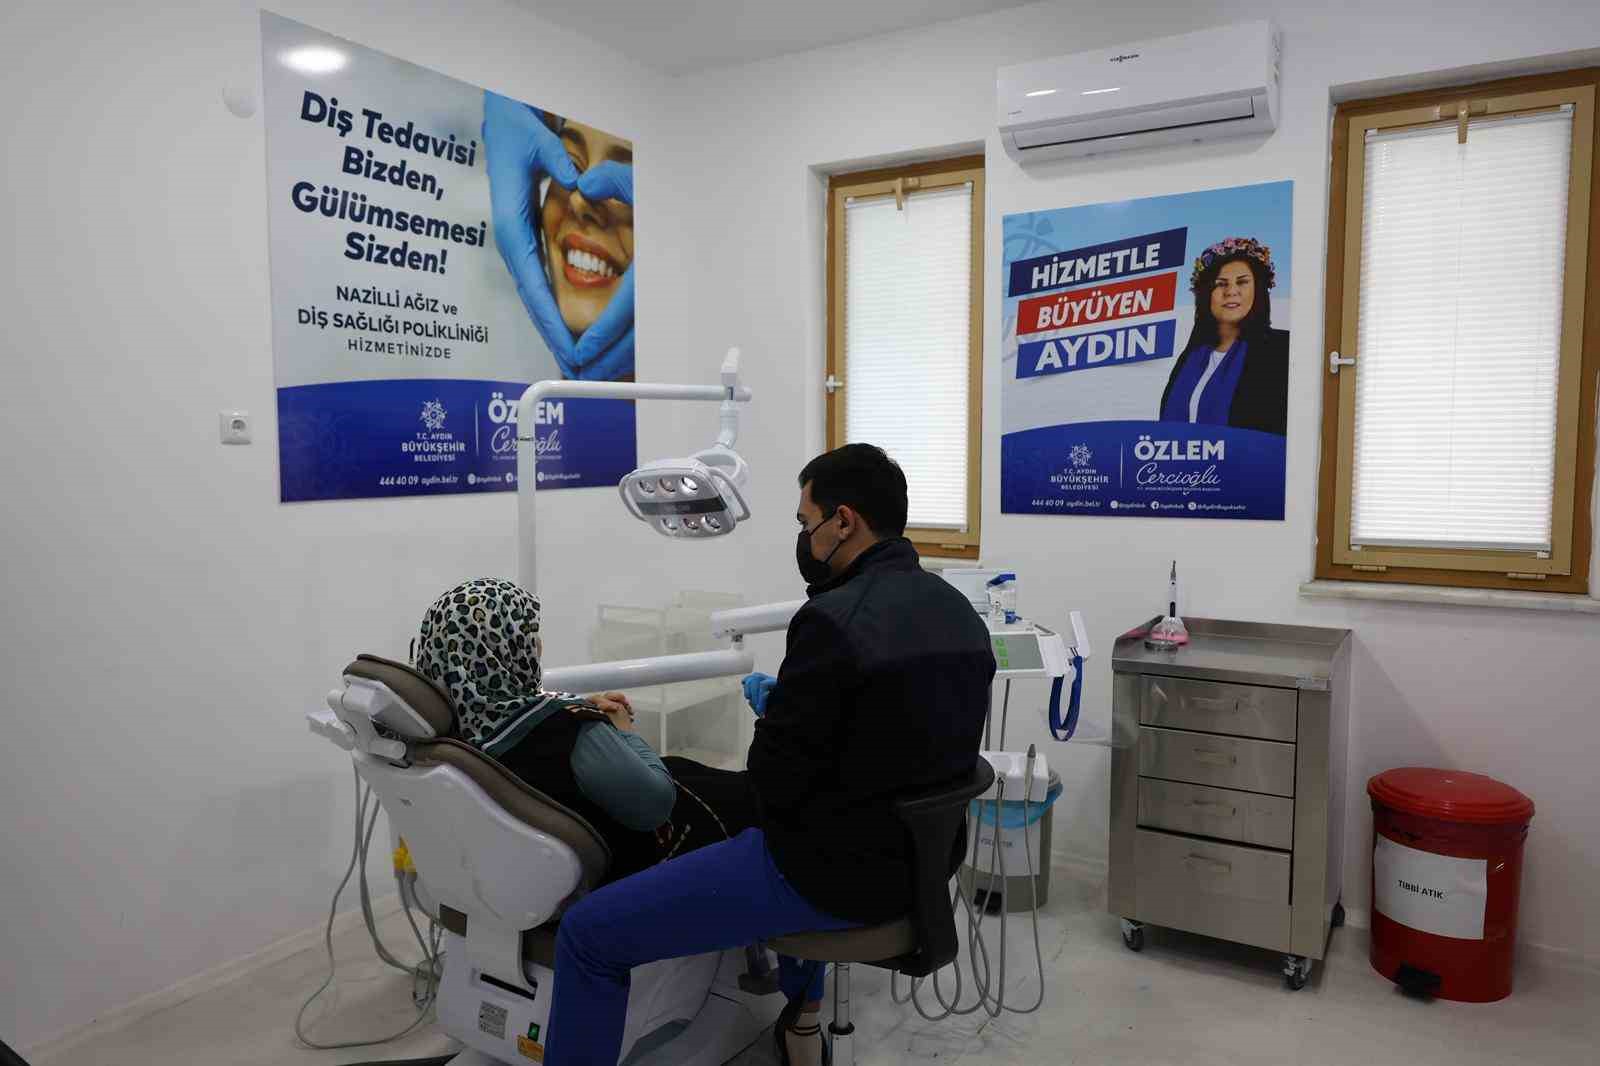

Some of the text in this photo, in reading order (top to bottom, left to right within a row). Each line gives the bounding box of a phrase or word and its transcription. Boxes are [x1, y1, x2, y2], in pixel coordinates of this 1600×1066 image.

[301, 90, 477, 167] Diş Tedavisi
[342, 145, 444, 200] Bizden,
[292, 181, 486, 247] Gülümsemesi
[344, 231, 447, 275] Sizden!
[1031, 242, 1161, 289] HİZMETLE
[336, 285, 458, 315] NAZİLLİ AĞIZ ve
[1037, 287, 1154, 329] BÜYÜYEN
[298, 306, 489, 344] DİŞ SAĞLIĞI POLİKLİNİĞİ
[347, 337, 452, 359] HİZMETİNİZDE
[1034, 325, 1157, 372] AYDIN
[488, 392, 564, 425] ÖZEM
[401, 441, 466, 454] BÜYÜKŞEHİR
[416, 433, 429, 441] T.C.
[1134, 435, 1225, 461] ÖZLEM
[379, 476, 395, 486] 444
[396, 475, 408, 486] 40
[408, 475, 419, 486] 09
[1050, 474, 1109, 485] BÜYÜKŞEHİR
[1136, 462, 1221, 487] Cercioğlu
[1422, 887, 1443, 899] ATIK
